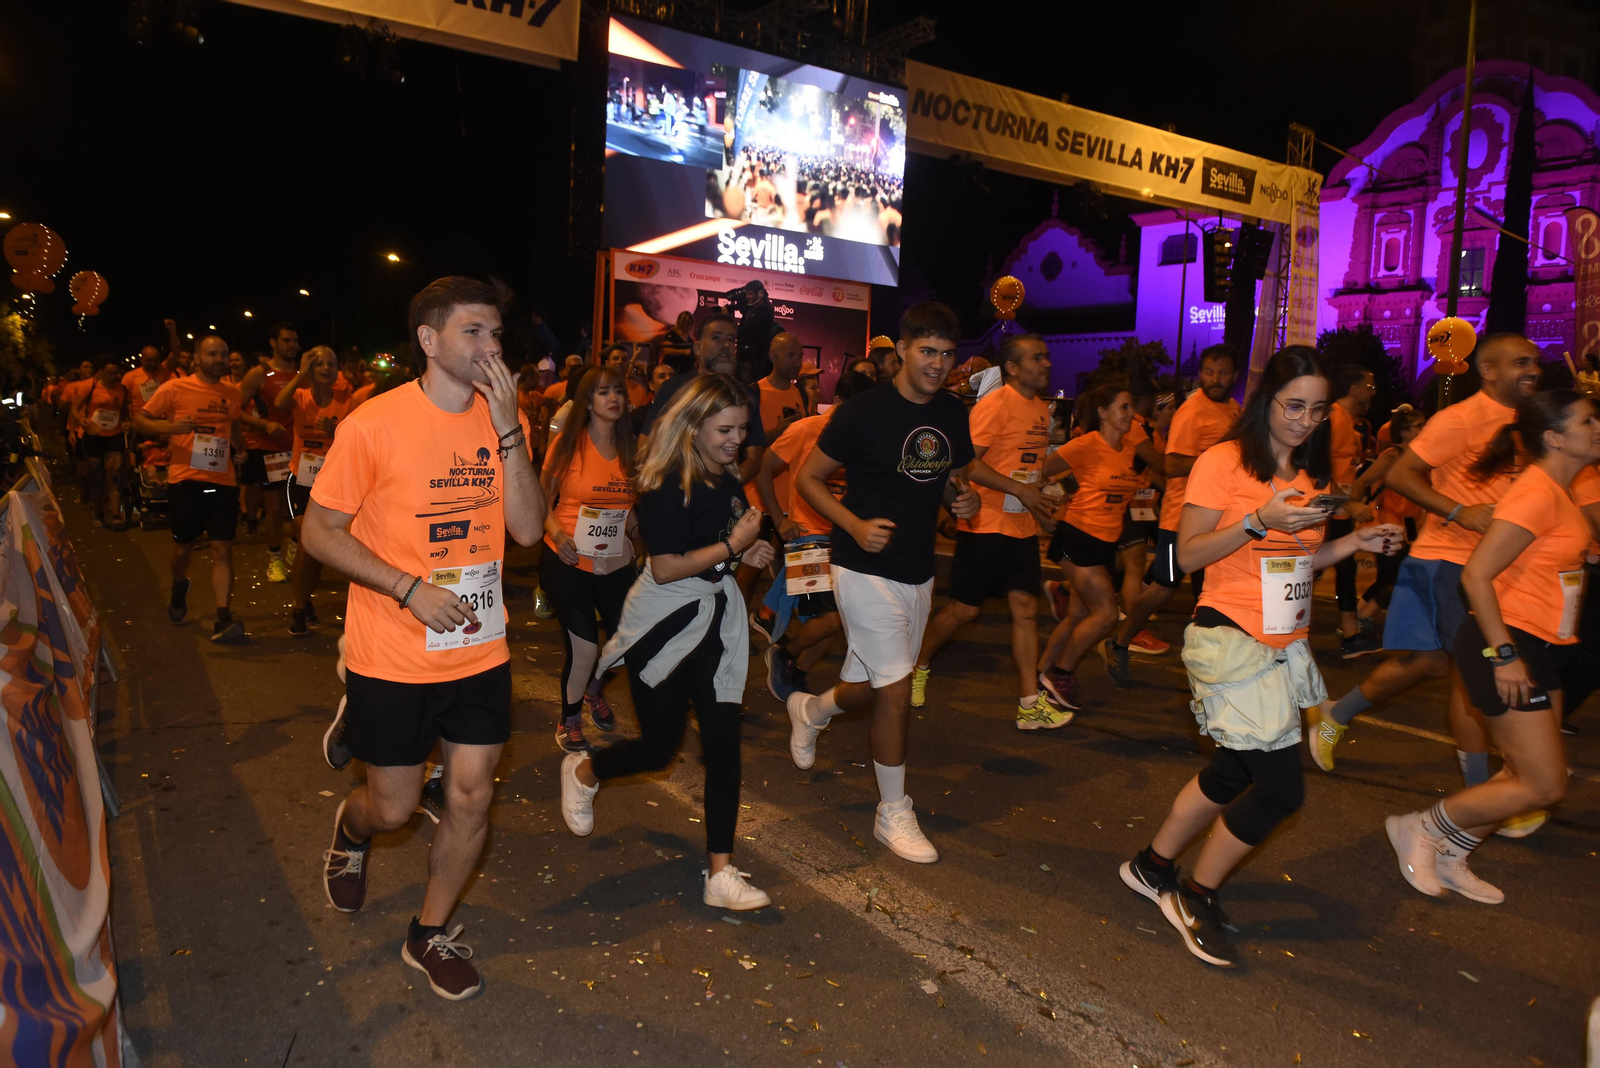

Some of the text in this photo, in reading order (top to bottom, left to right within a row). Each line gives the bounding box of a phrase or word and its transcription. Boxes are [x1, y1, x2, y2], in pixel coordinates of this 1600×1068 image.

[911, 88, 1048, 147] NOCTURNA
[1055, 127, 1143, 171] SEVILLA
[667, 267, 682, 276] ABC
[689, 272, 721, 283] Cruzcampo
[449, 468, 496, 477] NOCTURNA
[429, 478, 470, 489] SEVILLA
[587, 524, 618, 538] 20459
